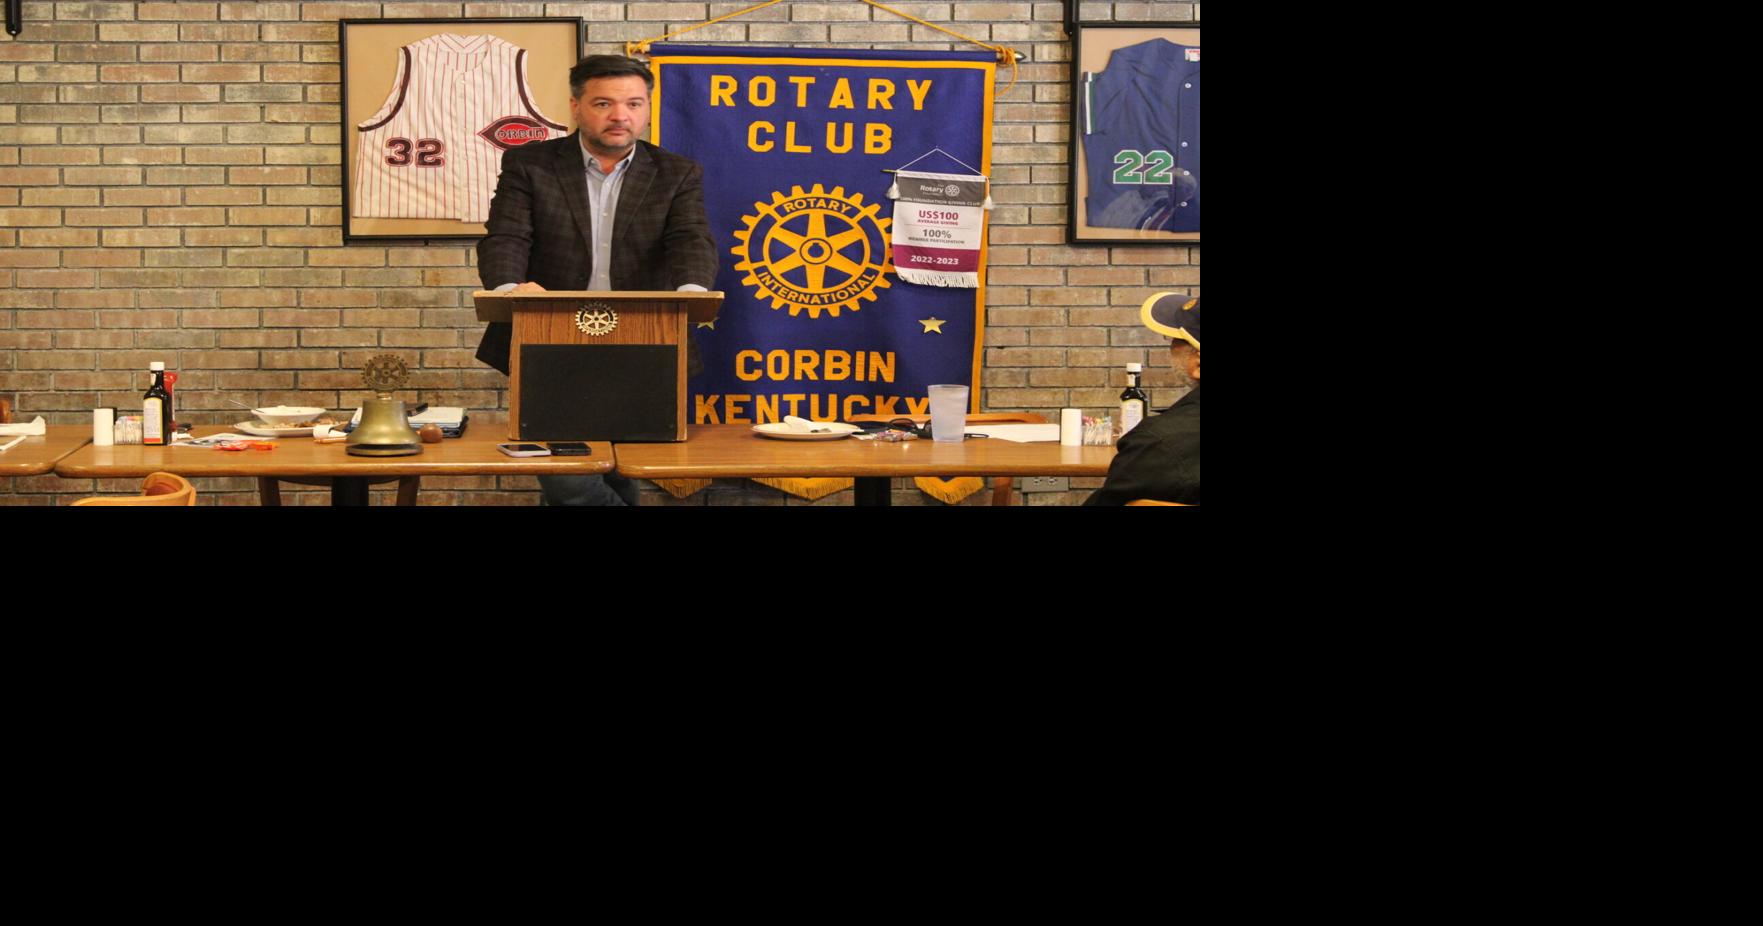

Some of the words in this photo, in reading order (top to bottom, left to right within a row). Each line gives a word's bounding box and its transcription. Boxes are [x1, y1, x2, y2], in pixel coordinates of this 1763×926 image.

[710, 75, 932, 111] ROTARY
[385, 137, 445, 168] 32
[747, 120, 892, 154] CLUB
[1113, 150, 1174, 184] 22
[920, 184, 944, 193] Rotary
[782, 198, 852, 214] ROTARY
[923, 229, 952, 238] 100%
[911, 255, 959, 265] 2022-2023
[758, 271, 876, 305] INTERNATIONAL
[735, 349, 896, 383] CORBIN
